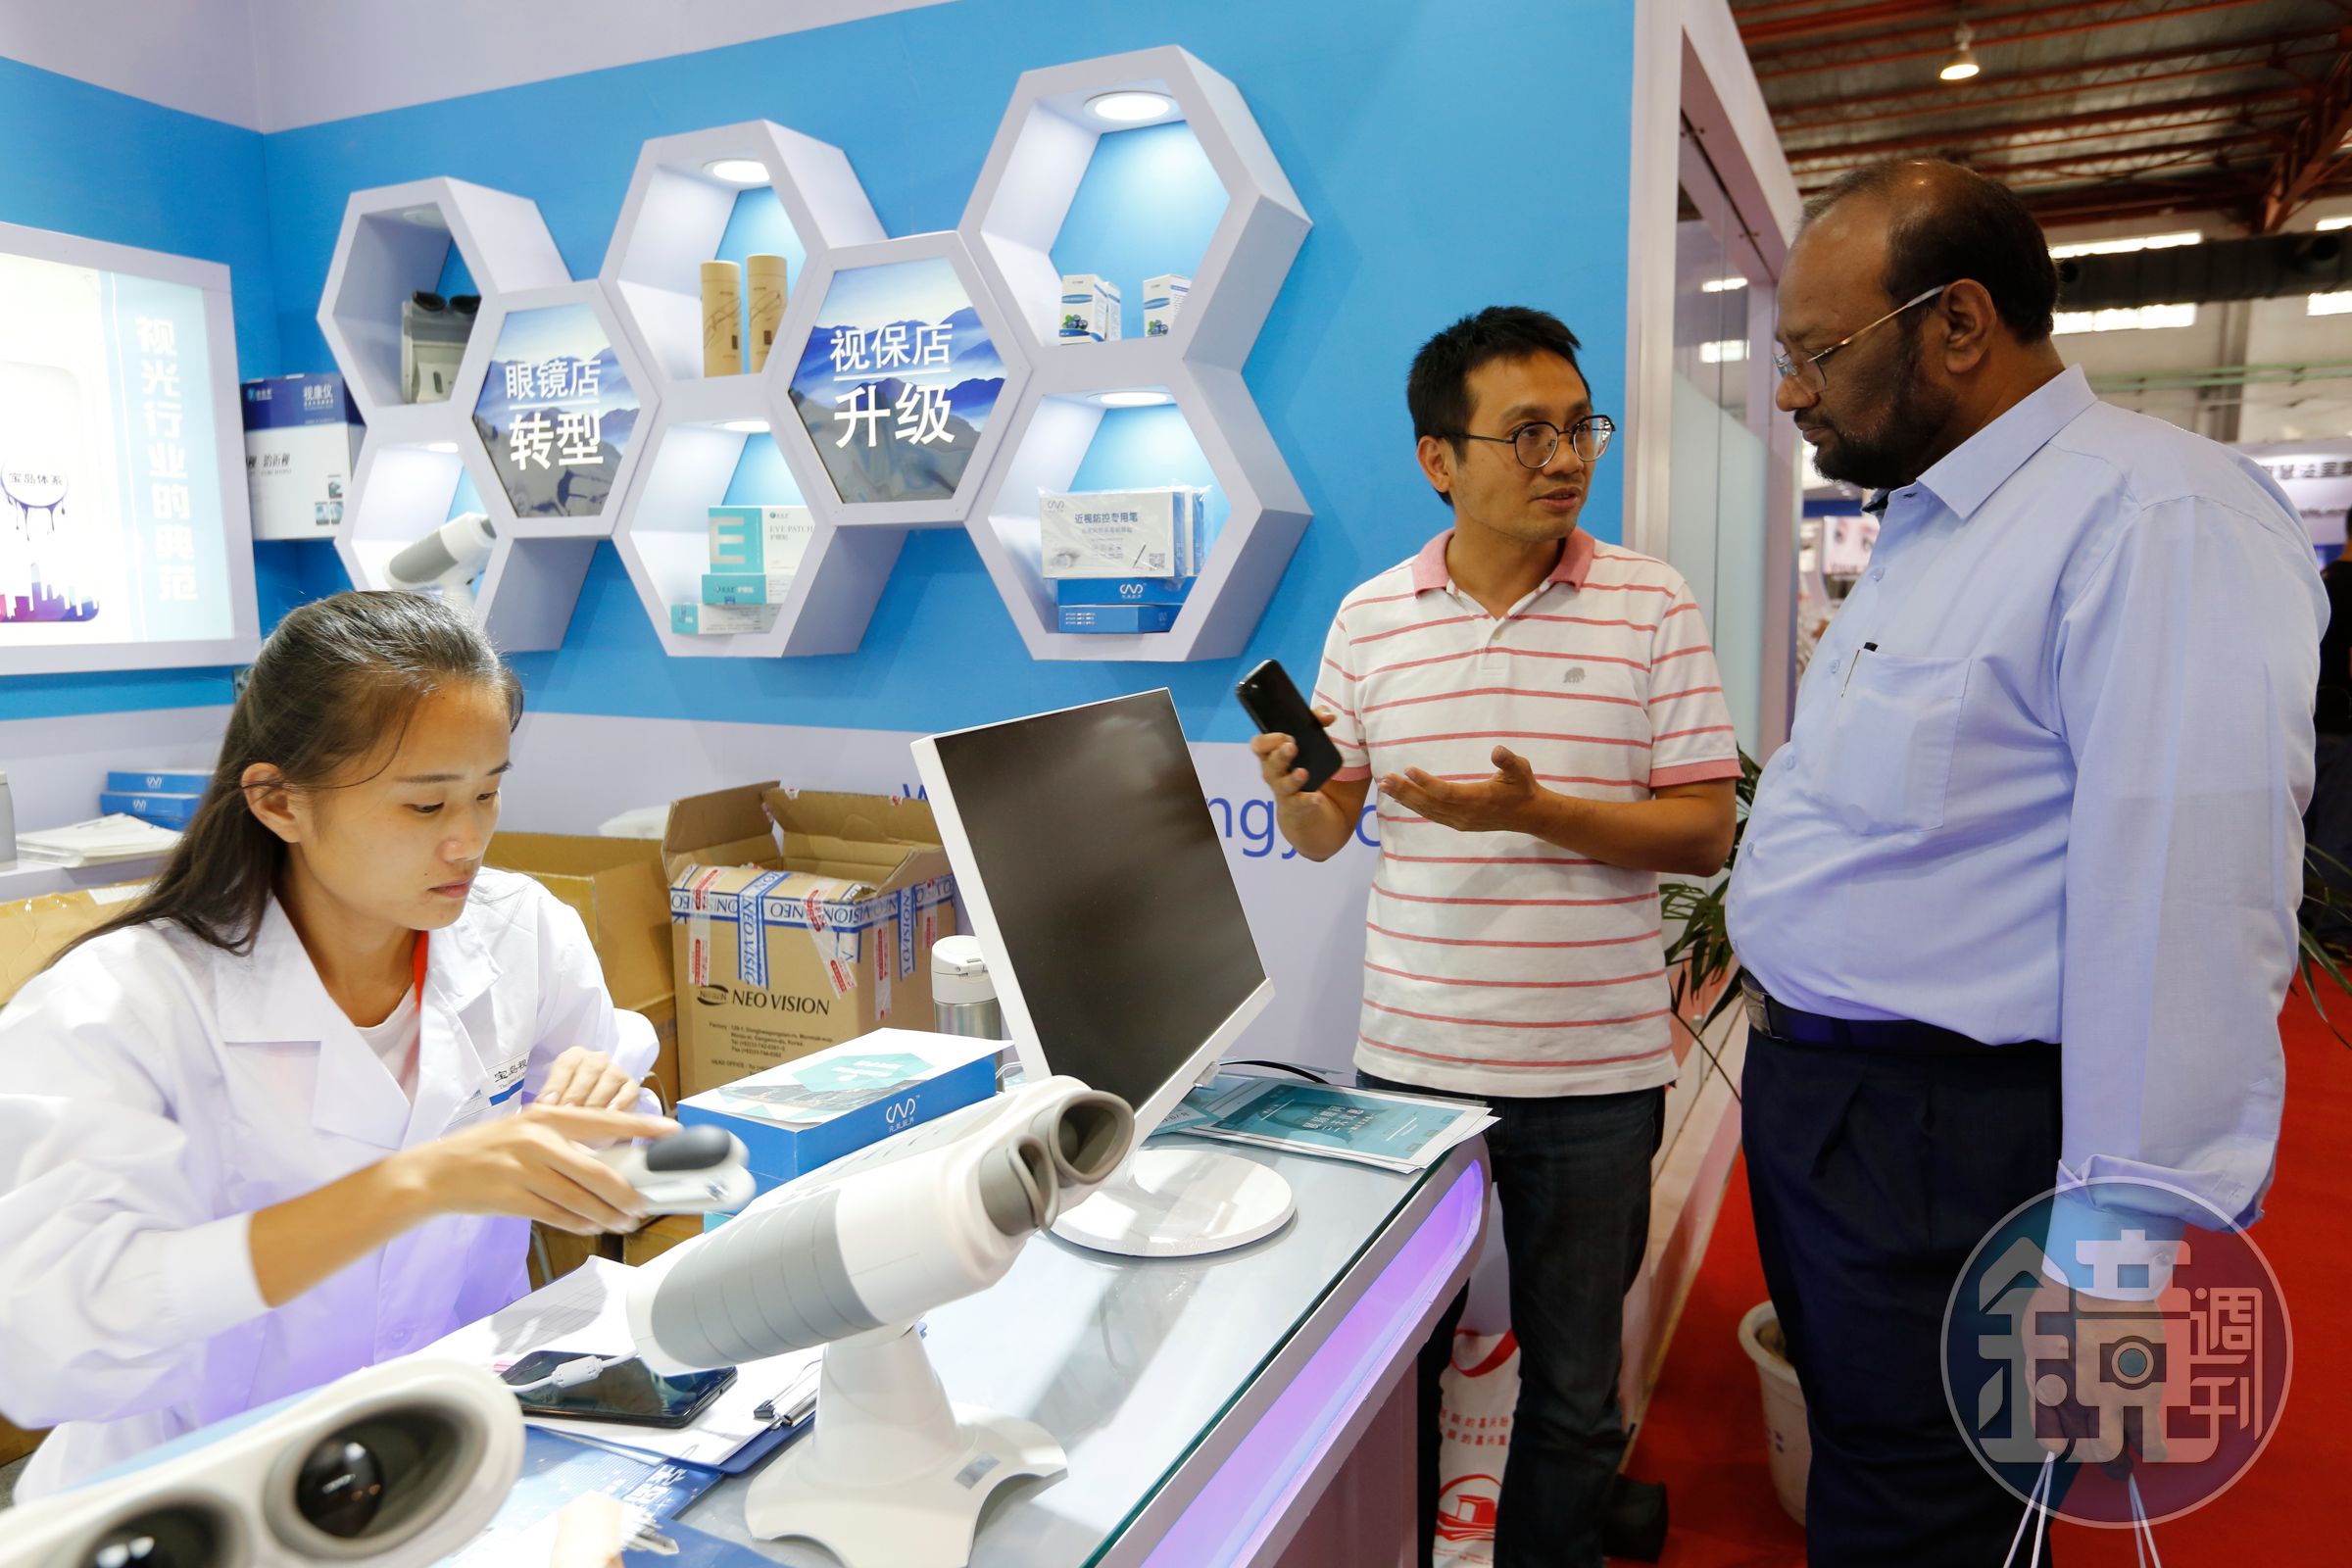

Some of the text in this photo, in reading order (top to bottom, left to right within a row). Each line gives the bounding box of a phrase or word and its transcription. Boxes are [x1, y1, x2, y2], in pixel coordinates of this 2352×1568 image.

[829, 323, 954, 372] 视保店
[505, 359, 602, 401] 眼镜店
[833, 382, 956, 449] 升级
[135, 317, 198, 602] 视光行业的典范
[509, 409, 605, 471] 转型
[9, 471, 63, 486] 宝岛体系
[709, 515, 745, 565] E
[769, 524, 788, 534] EYE
[1075, 512, 1139, 524] 近视防控专用笔
[732, 989, 767, 1009] NEO
[770, 994, 830, 1016] VISION
